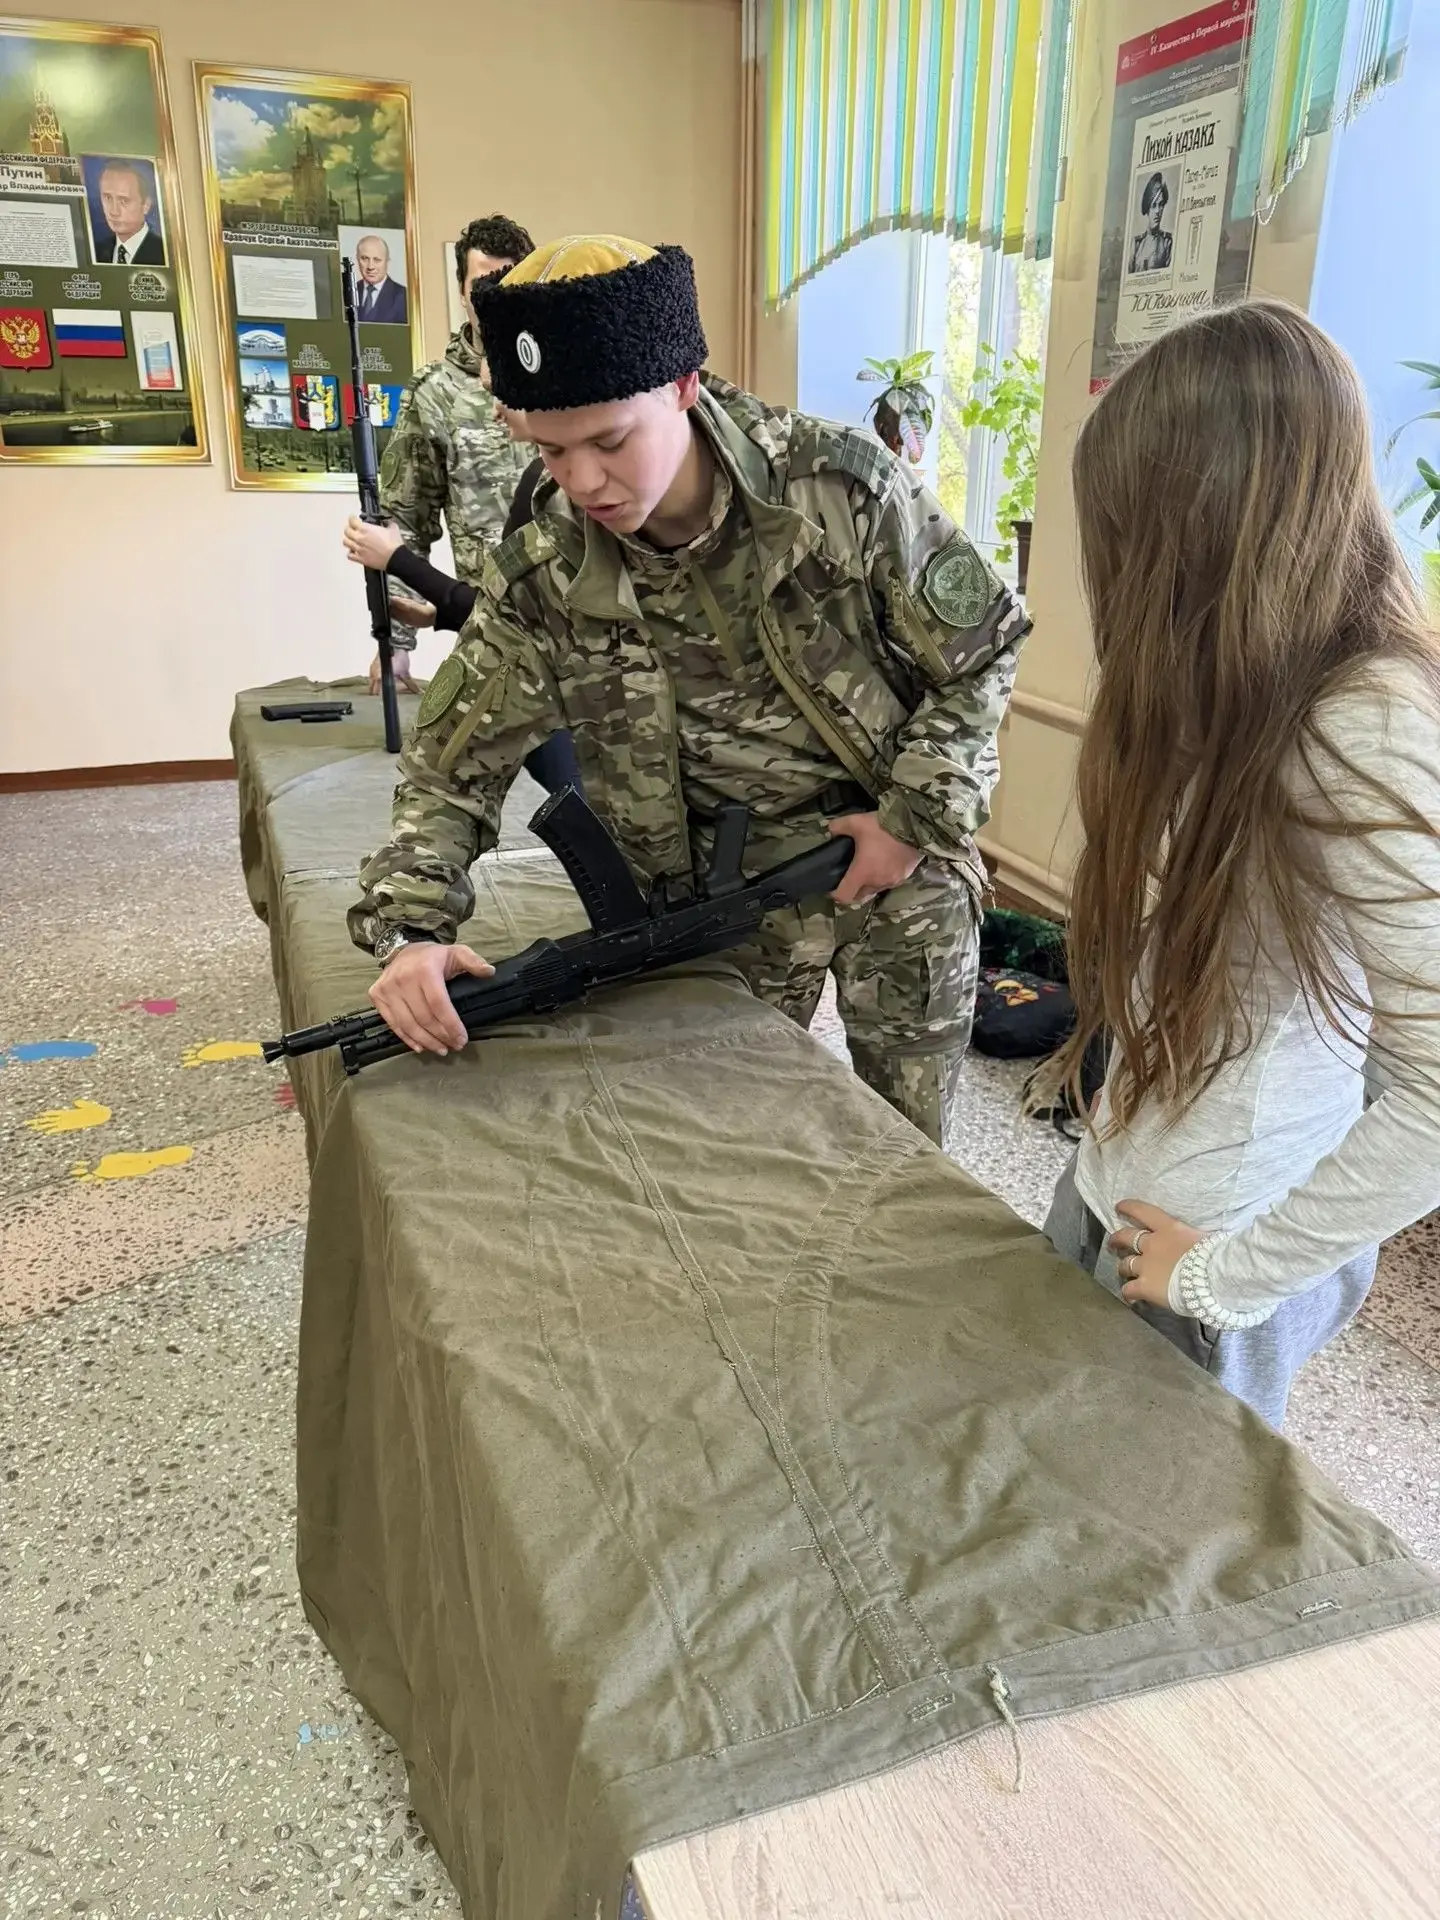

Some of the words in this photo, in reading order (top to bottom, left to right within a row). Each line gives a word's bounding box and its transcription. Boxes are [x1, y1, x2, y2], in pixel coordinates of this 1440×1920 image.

[0, 153, 39, 162] ОССИЙСКОЙ
[1, 166, 43, 179] Путин
[9, 180, 84, 193] Владимирович
[223, 232, 257, 243] Кравчук
[258, 234, 286, 246] Сергей
[286, 237, 338, 249] Анатольевич
[0, 280, 33, 289] ОССИЙСКОЙ
